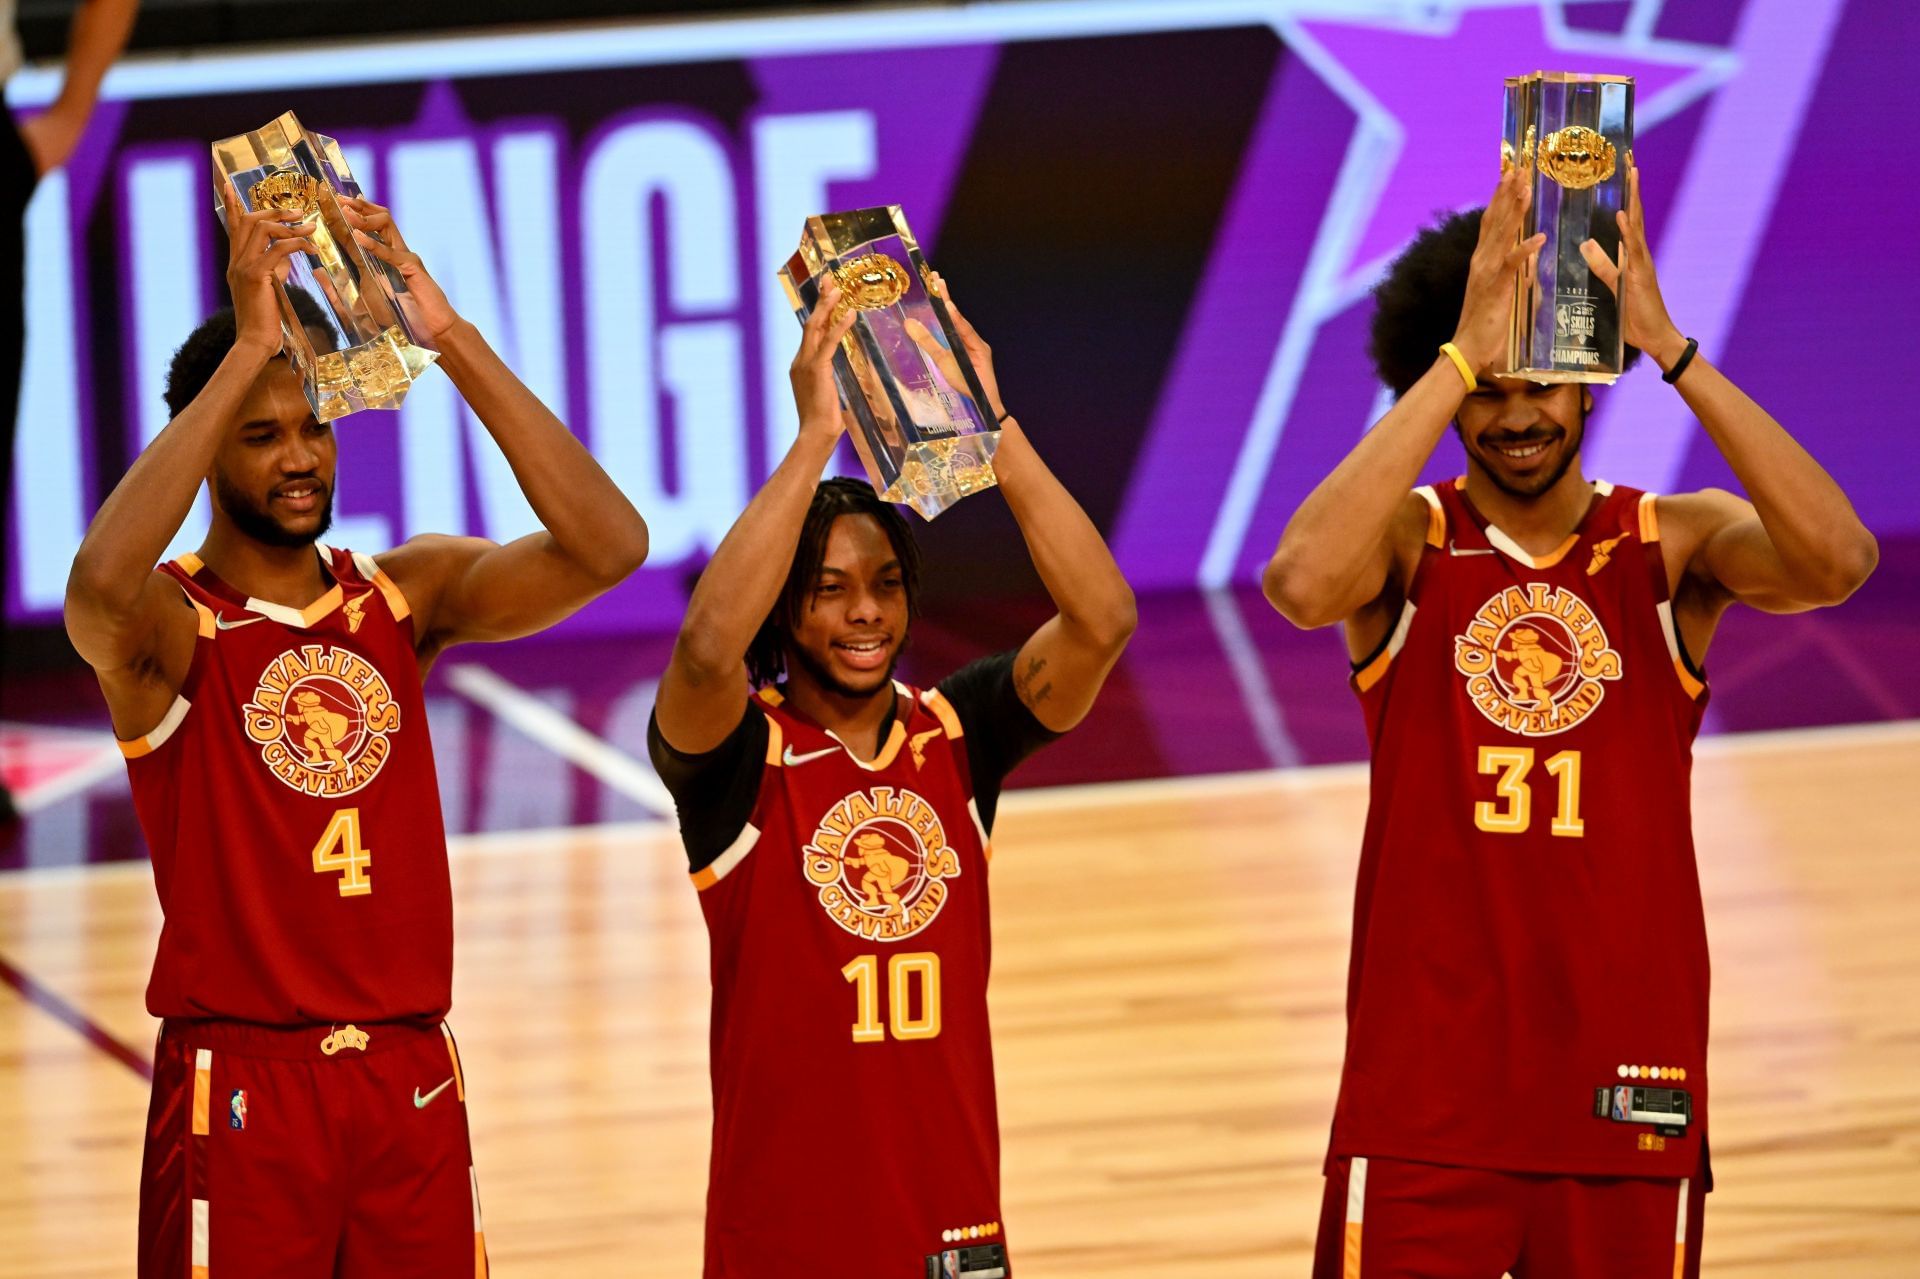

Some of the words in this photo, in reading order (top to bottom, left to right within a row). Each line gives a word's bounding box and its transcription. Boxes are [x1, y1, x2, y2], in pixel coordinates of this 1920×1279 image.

[1549, 348, 1600, 365] CHAMPIONS
[1570, 316, 1595, 330] SKILLS
[1455, 583, 1623, 680] CAVALIERS
[243, 645, 401, 744] CAVALIERS
[1467, 675, 1604, 737] CLEVELAND
[262, 735, 391, 798] CLEVELAND
[1474, 745, 1585, 838] 31
[312, 807, 372, 897] 4
[802, 786, 961, 887] CAVALIERS
[818, 879, 948, 942] CLEVELAND
[841, 951, 942, 1043] 10
